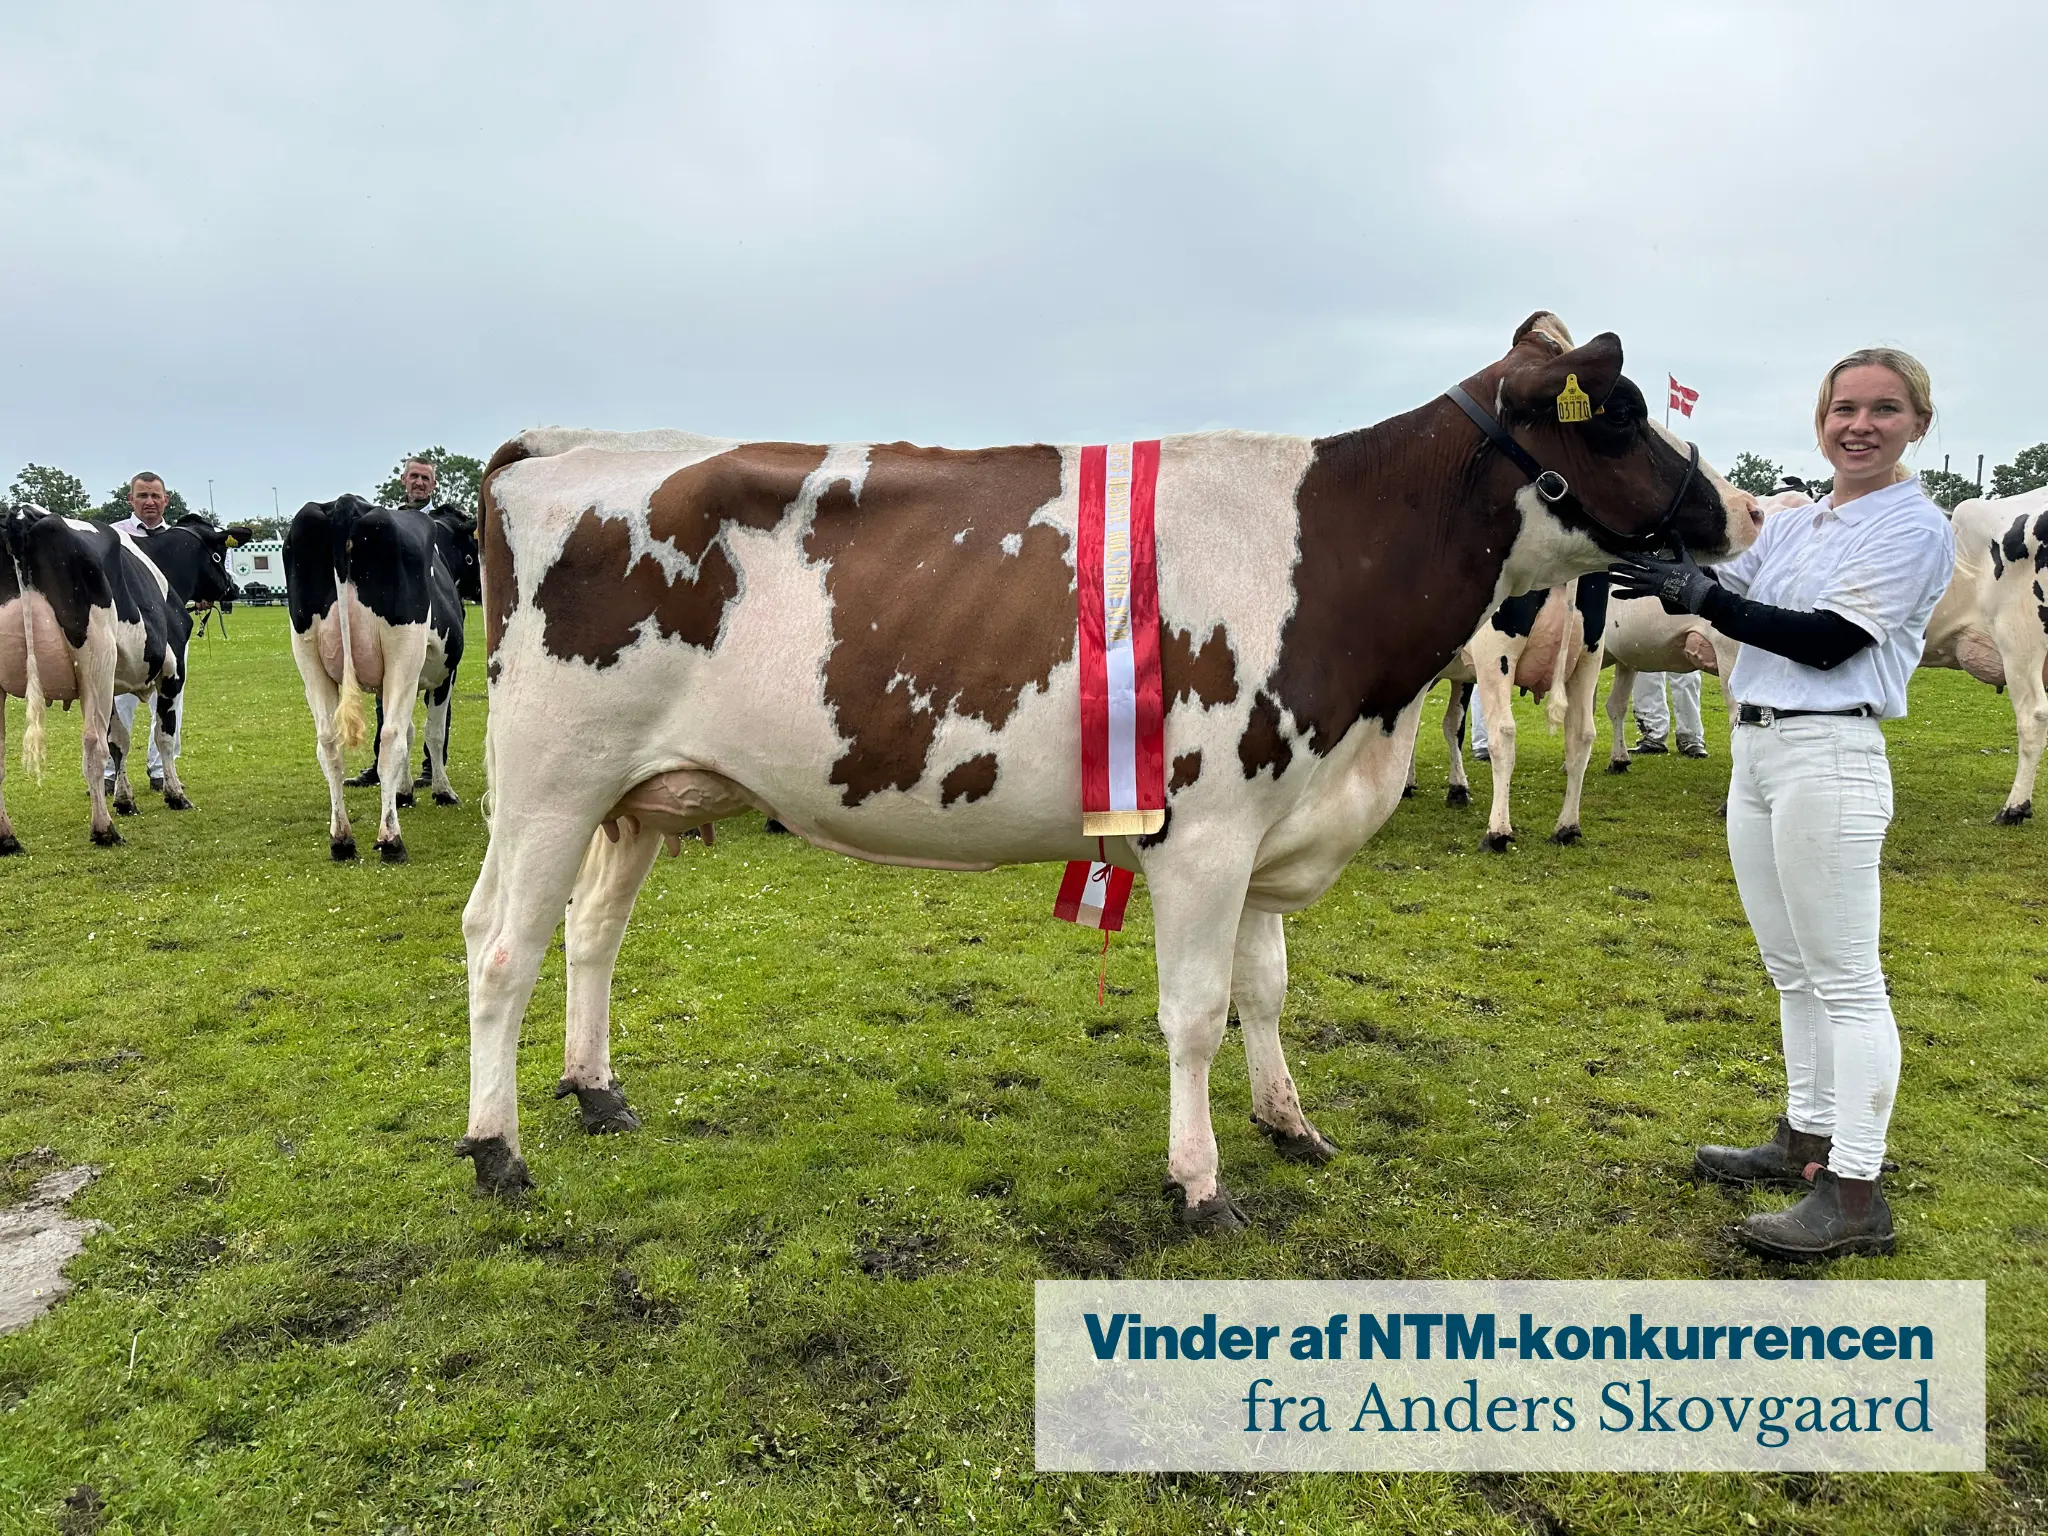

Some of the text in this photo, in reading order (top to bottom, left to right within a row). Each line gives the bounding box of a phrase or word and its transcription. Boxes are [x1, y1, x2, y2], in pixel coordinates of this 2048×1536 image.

[1558, 400, 1590, 420] 03770
[1107, 476, 1130, 524] BEDSTE
[1106, 530, 1130, 597] HOLSTEIN
[1107, 605, 1130, 641] NTM
